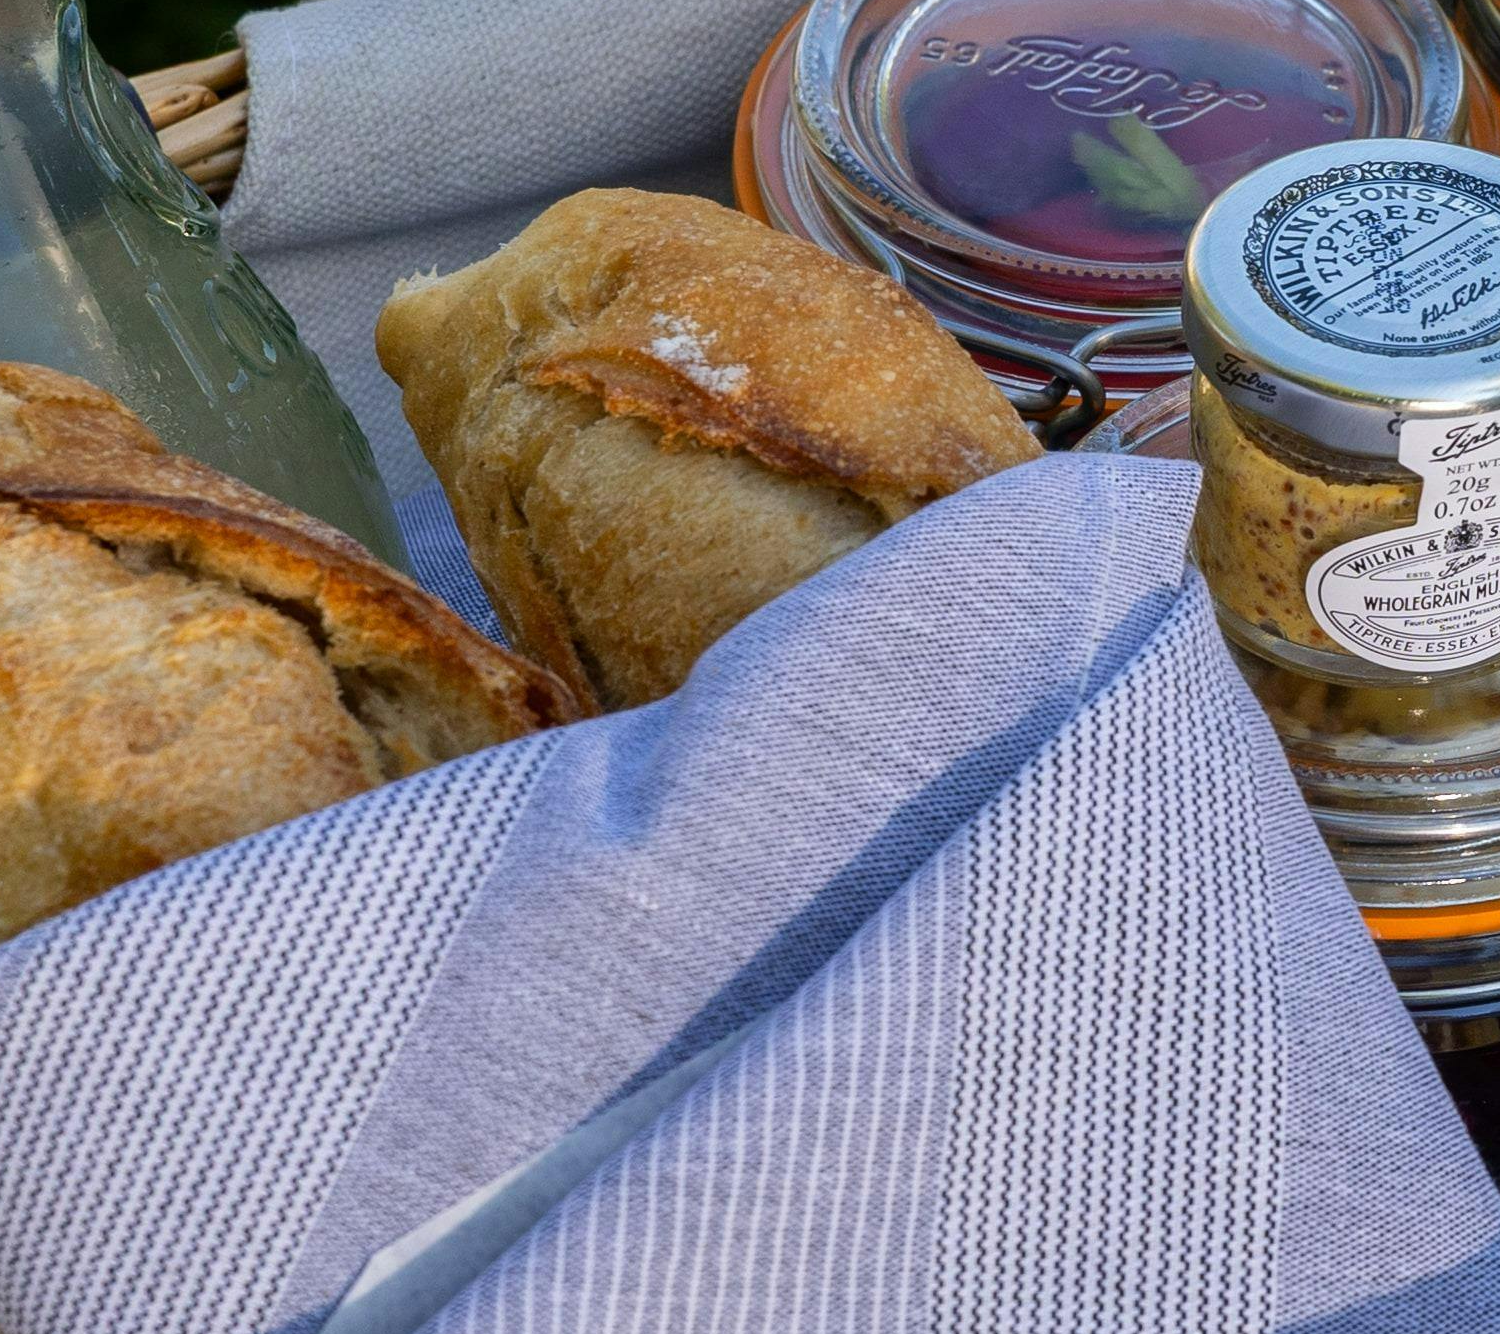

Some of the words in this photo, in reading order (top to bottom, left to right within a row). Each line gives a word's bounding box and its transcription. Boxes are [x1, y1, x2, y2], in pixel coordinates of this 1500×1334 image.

[1274, 216, 1324, 312] WILKIN
[1306, 204, 1339, 219] &
[1334, 185, 1437, 208] SONS
[1313, 204, 1441, 284] TIPTREE
[1324, 308, 1348, 326] Our
[1402, 258, 1440, 280] quality
[1439, 233, 1484, 261] products
[1353, 301, 1382, 318] been
[1428, 267, 1444, 278] on
[1442, 257, 1462, 269] the
[1409, 280, 1443, 300] farms
[1440, 266, 1469, 284] since
[1467, 251, 1494, 267] 1885
[1382, 332, 1418, 344] None
[1421, 327, 1468, 345] genuine
[1445, 464, 1476, 477] NET
[1446, 475, 1492, 496] 20g
[1433, 494, 1498, 520] 0.7oz
[1347, 543, 1416, 576] WILKIN
[1426, 539, 1440, 553] &
[1363, 586, 1471, 612] WHOLEGRAIN
[1421, 569, 1500, 595] ENGLISH
[1348, 619, 1415, 653] TIPTREE
[1424, 633, 1481, 653] ESSEX
